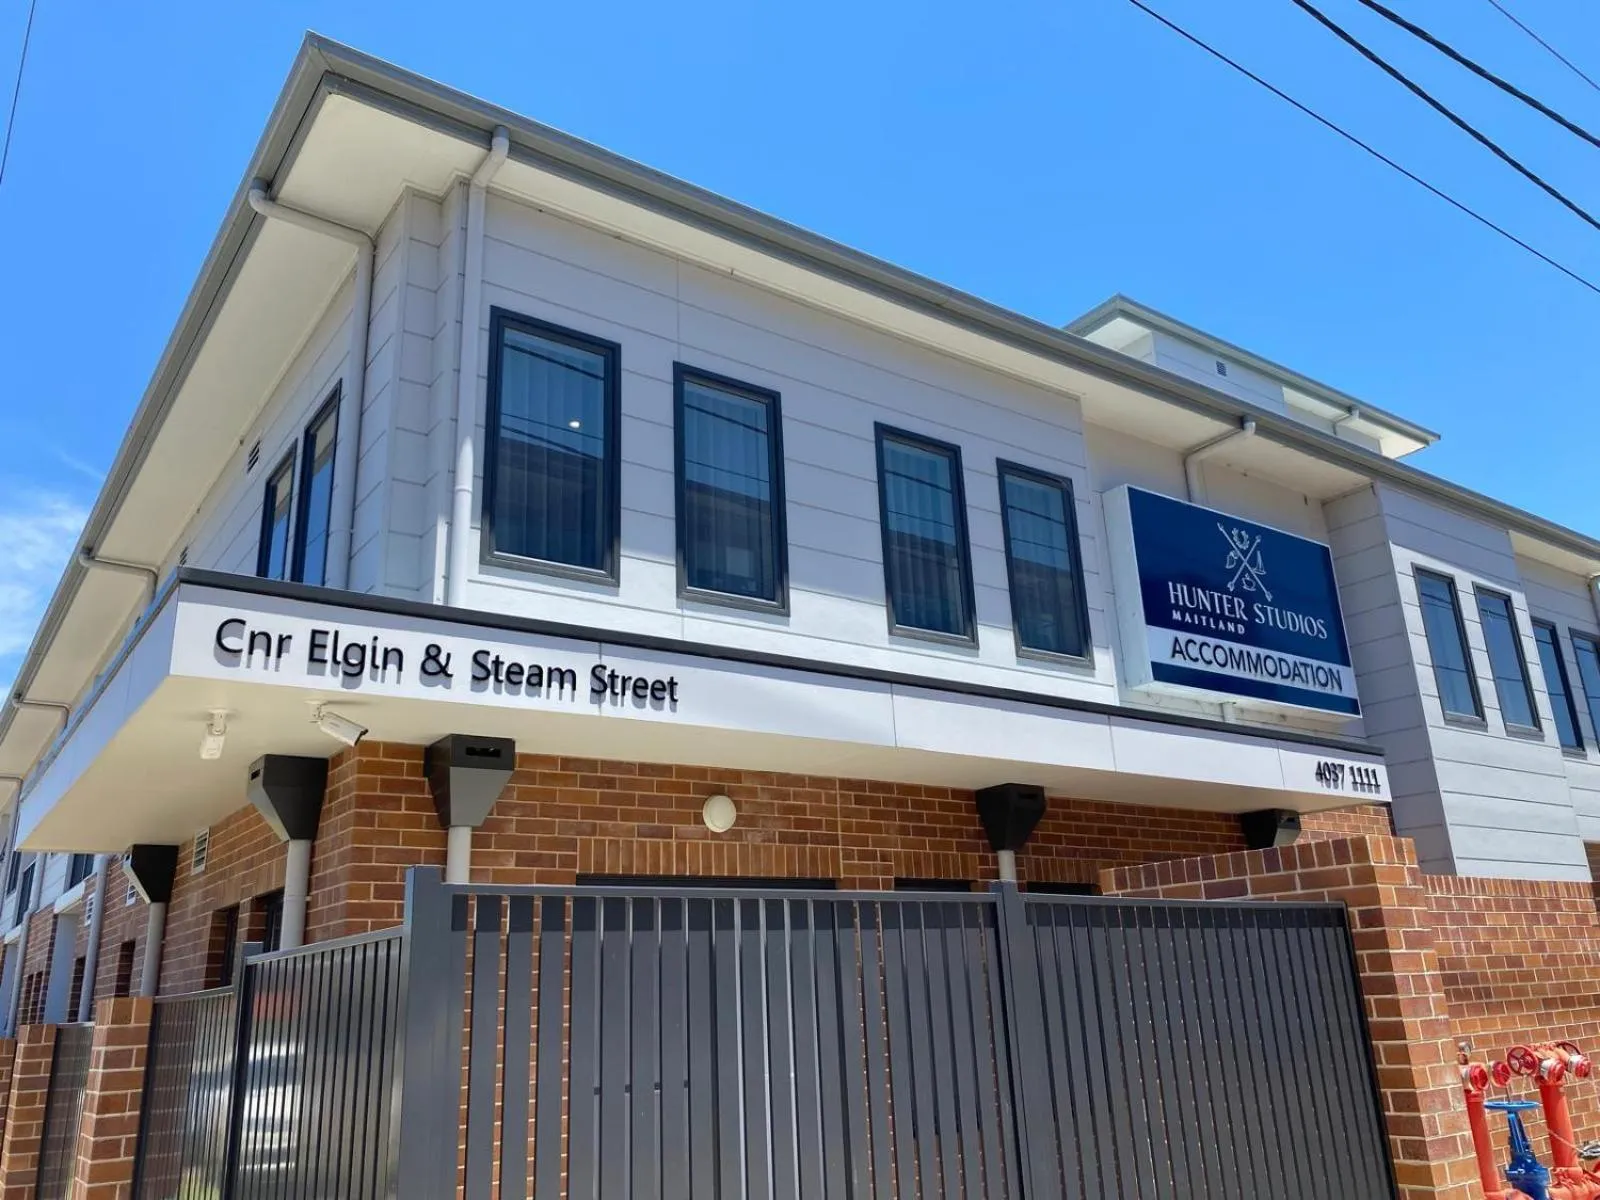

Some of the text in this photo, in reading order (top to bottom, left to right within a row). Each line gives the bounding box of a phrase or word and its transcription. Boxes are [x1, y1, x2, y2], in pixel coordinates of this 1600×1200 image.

[1169, 581, 1328, 639] HUNTER STUDIOS
[1172, 609, 1246, 635] MAITLAND
[215, 617, 680, 704] Cnr Elgin & Steam Street
[1171, 637, 1343, 693] ACCOMMODATION
[1315, 761, 1381, 788] 4037 1111
